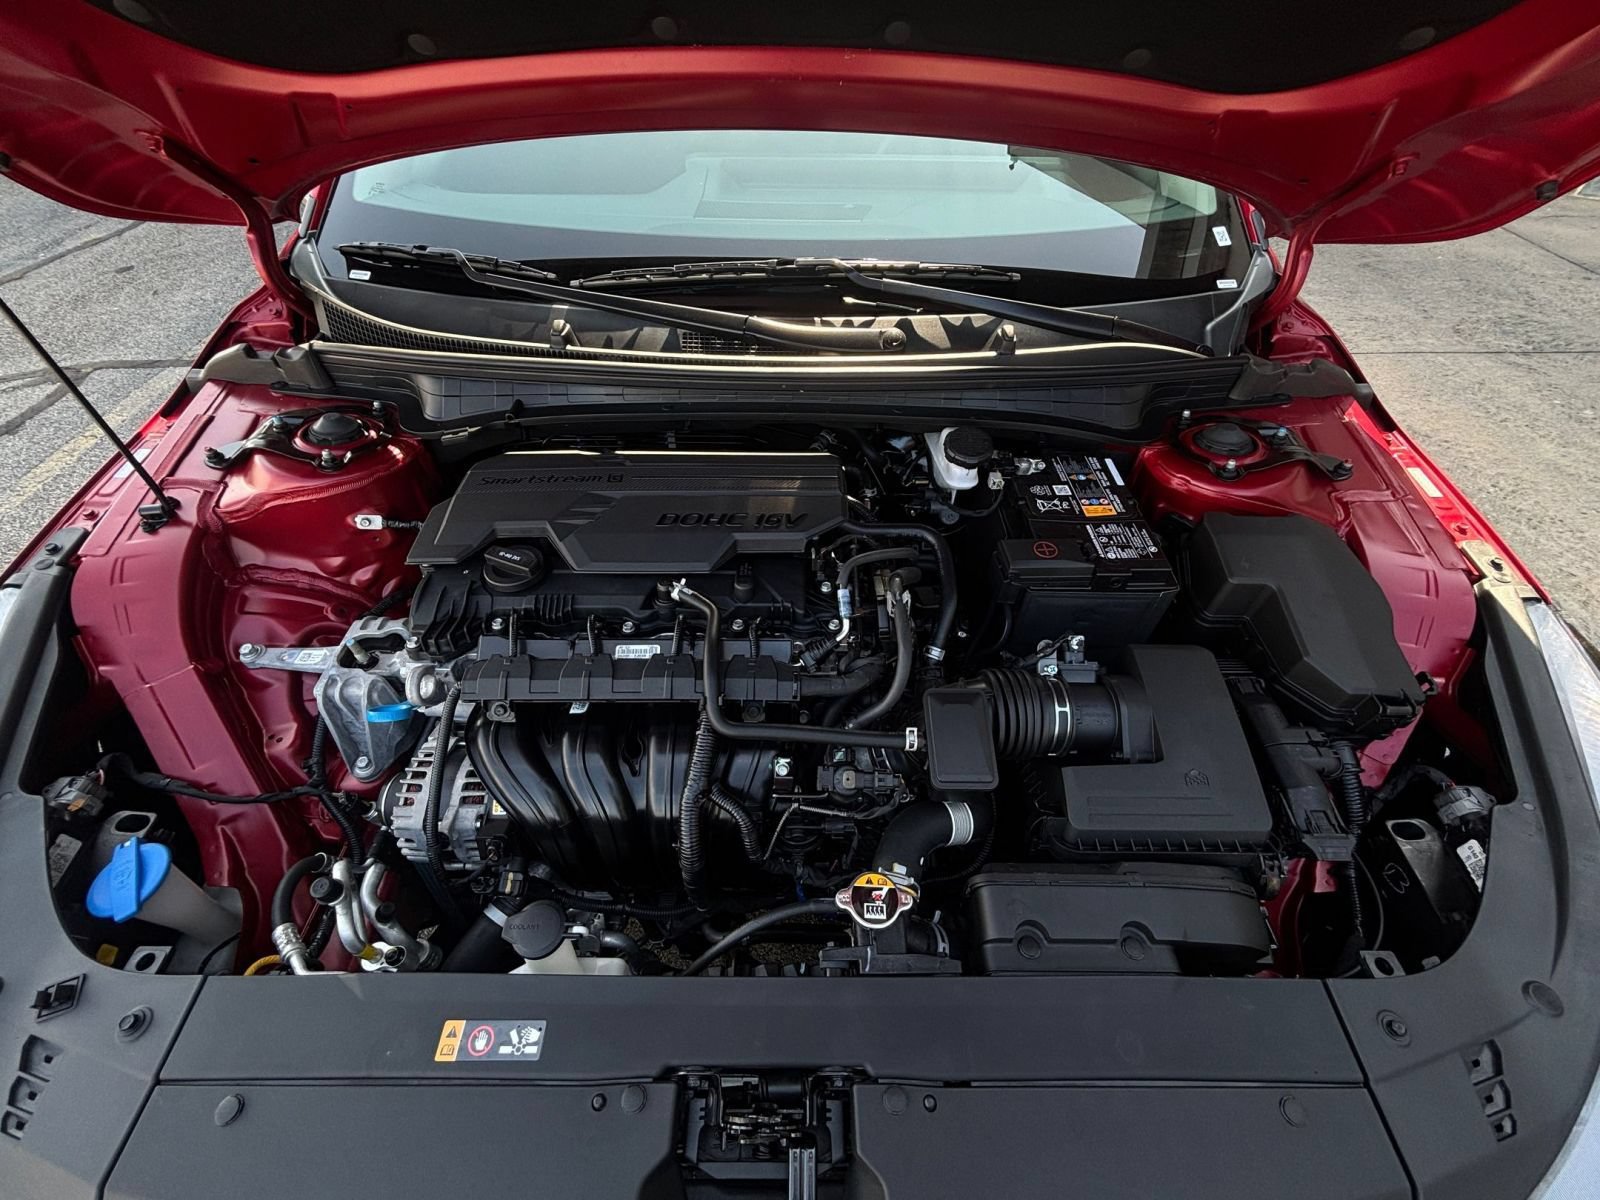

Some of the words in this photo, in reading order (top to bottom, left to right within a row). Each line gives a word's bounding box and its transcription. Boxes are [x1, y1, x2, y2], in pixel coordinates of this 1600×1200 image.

[478, 474, 603, 485] Smartstream
[655, 512, 749, 527] DOHC
[753, 512, 809, 528] 16V
[508, 921, 541, 930] COOLANT
